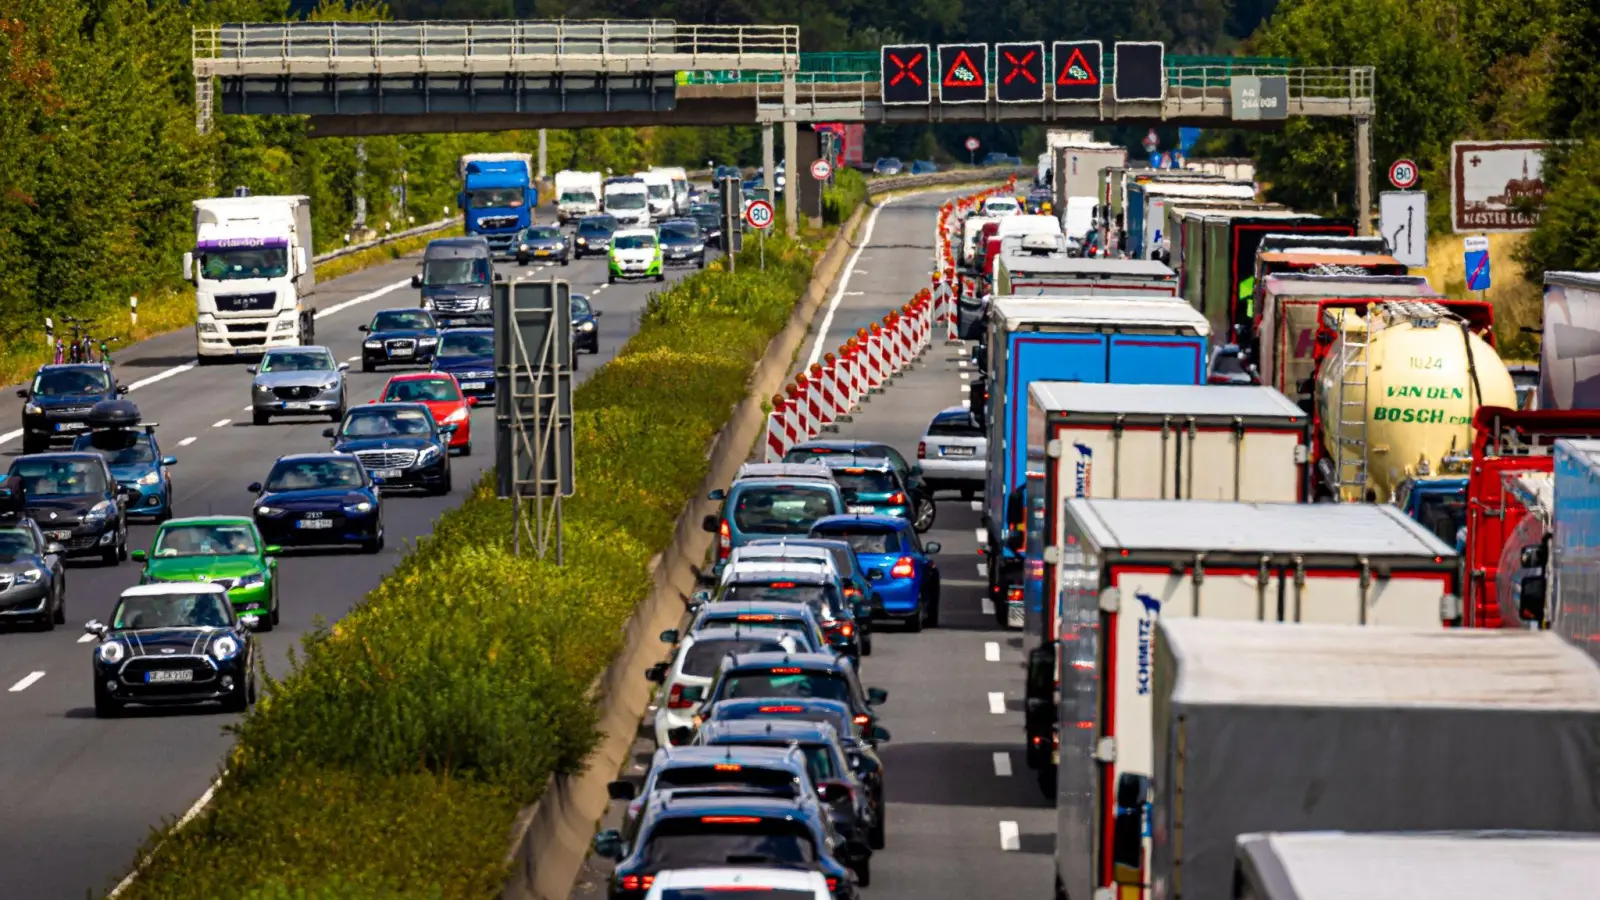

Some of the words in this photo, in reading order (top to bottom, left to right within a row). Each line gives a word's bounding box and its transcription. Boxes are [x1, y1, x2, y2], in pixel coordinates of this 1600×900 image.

[1396, 167, 1411, 180] 80
[752, 208, 768, 221] 80
[1464, 211, 1507, 225] KLOSTER
[1410, 357, 1442, 369] 1024
[1387, 386, 1422, 398] VAN
[1427, 387, 1463, 399] DEN
[1374, 406, 1444, 424] BOSCH
